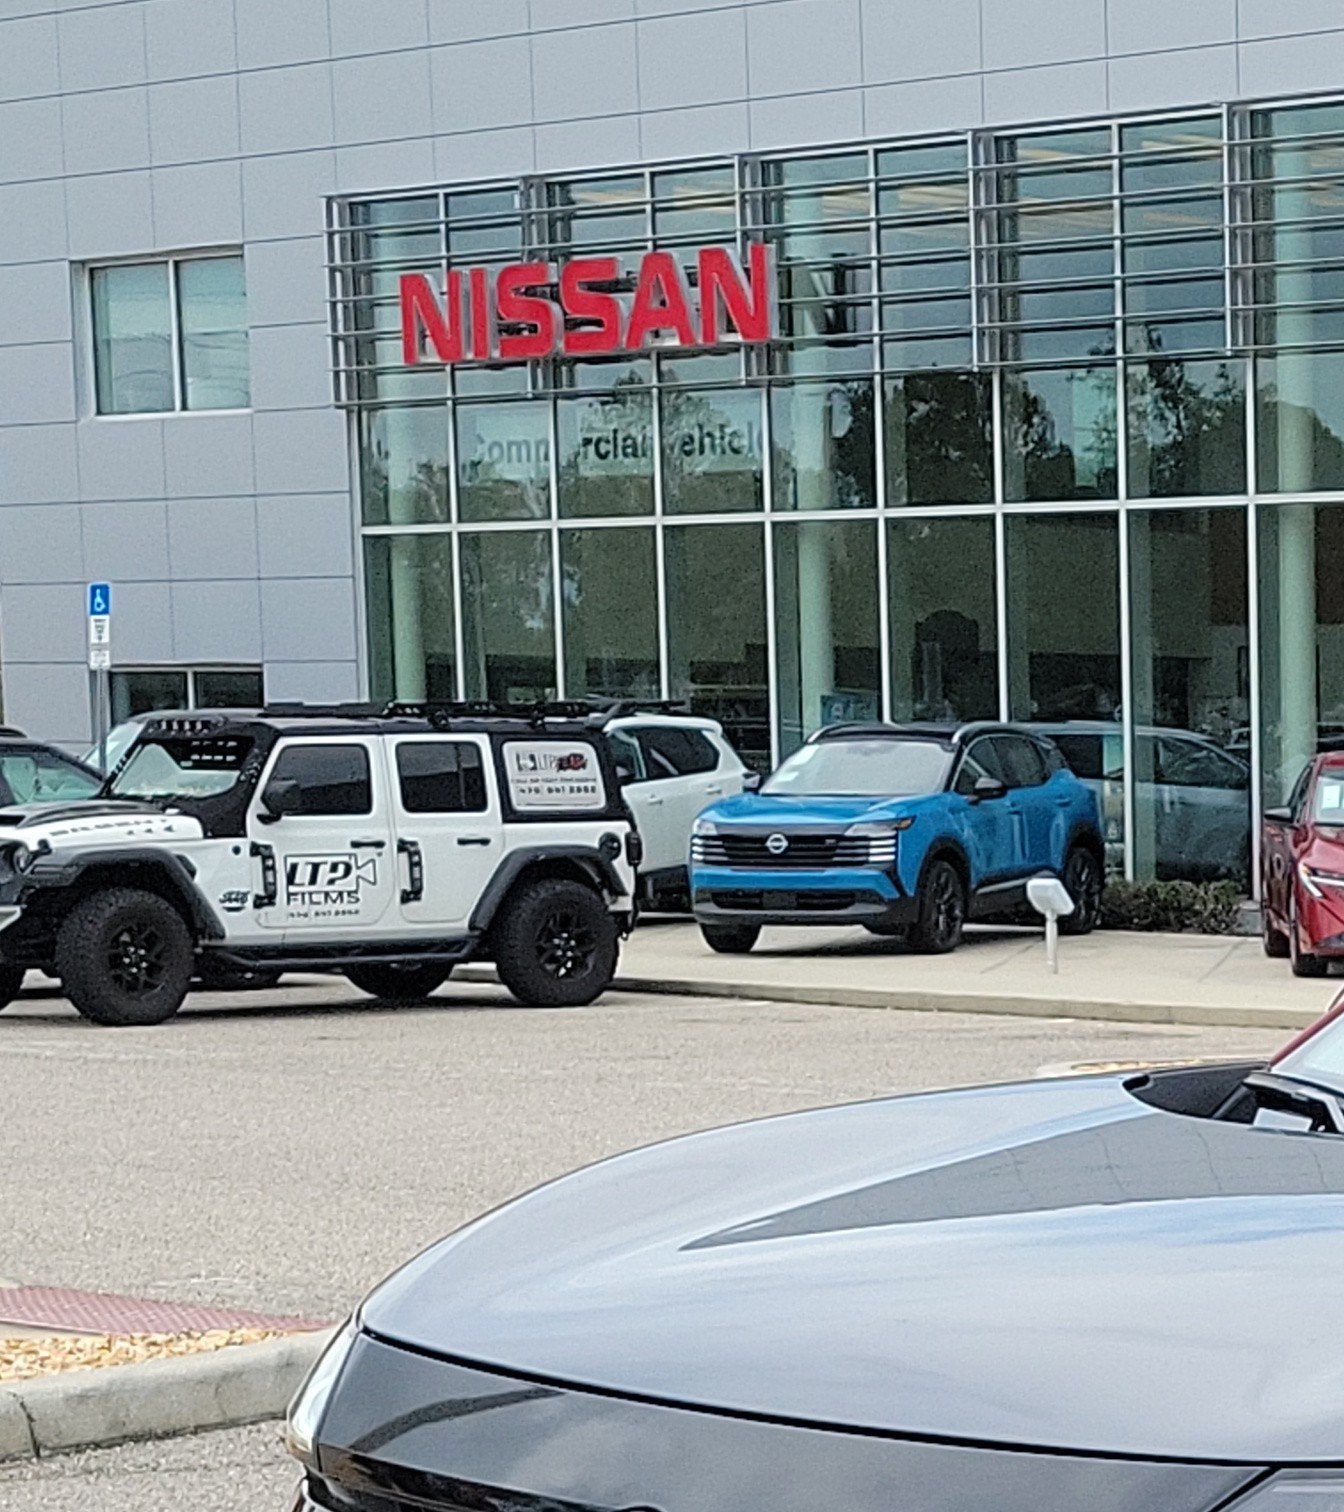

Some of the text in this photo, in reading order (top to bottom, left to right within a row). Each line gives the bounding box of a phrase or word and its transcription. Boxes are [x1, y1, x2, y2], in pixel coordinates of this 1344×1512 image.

[399, 242, 771, 366] NISSAN
[285, 860, 353, 888] LTP
[286, 890, 361, 906] FILMS
